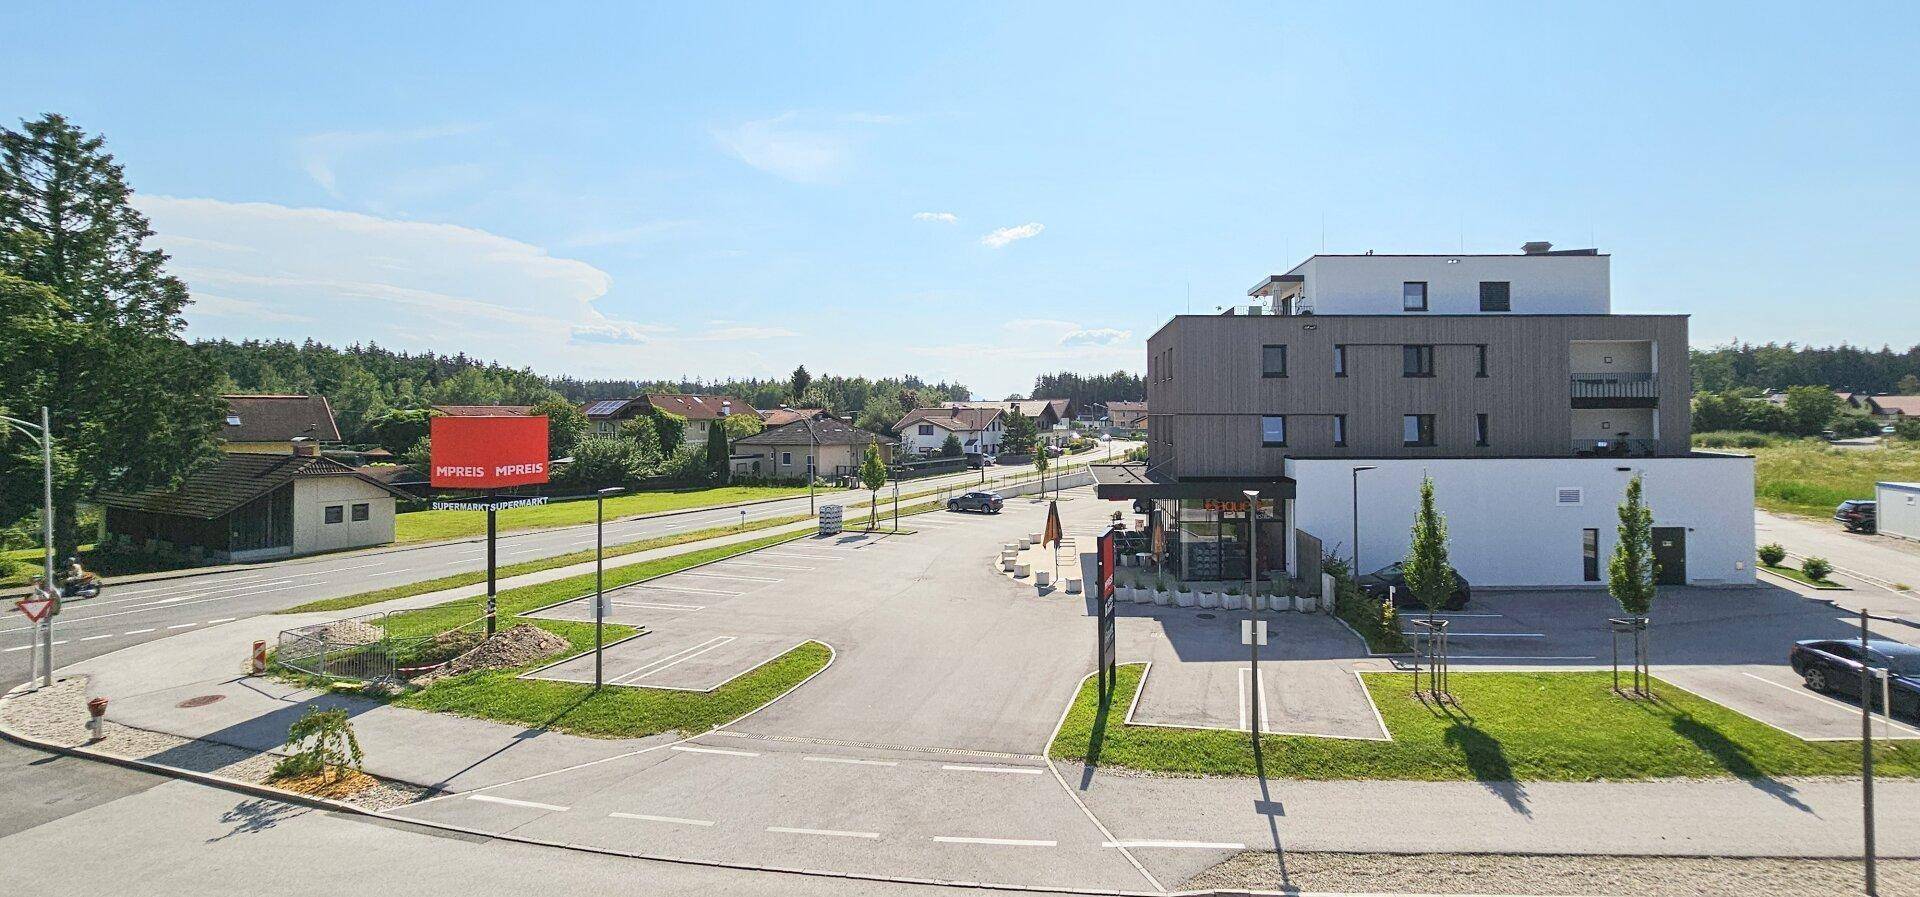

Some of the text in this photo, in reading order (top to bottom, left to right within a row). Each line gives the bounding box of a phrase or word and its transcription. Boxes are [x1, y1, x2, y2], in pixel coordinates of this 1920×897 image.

[436, 466, 485, 477] MPREIS
[495, 463, 544, 477] MPREIS
[432, 501, 490, 512] SUPERMARKT
[489, 496, 549, 512] SUPERMARKT
